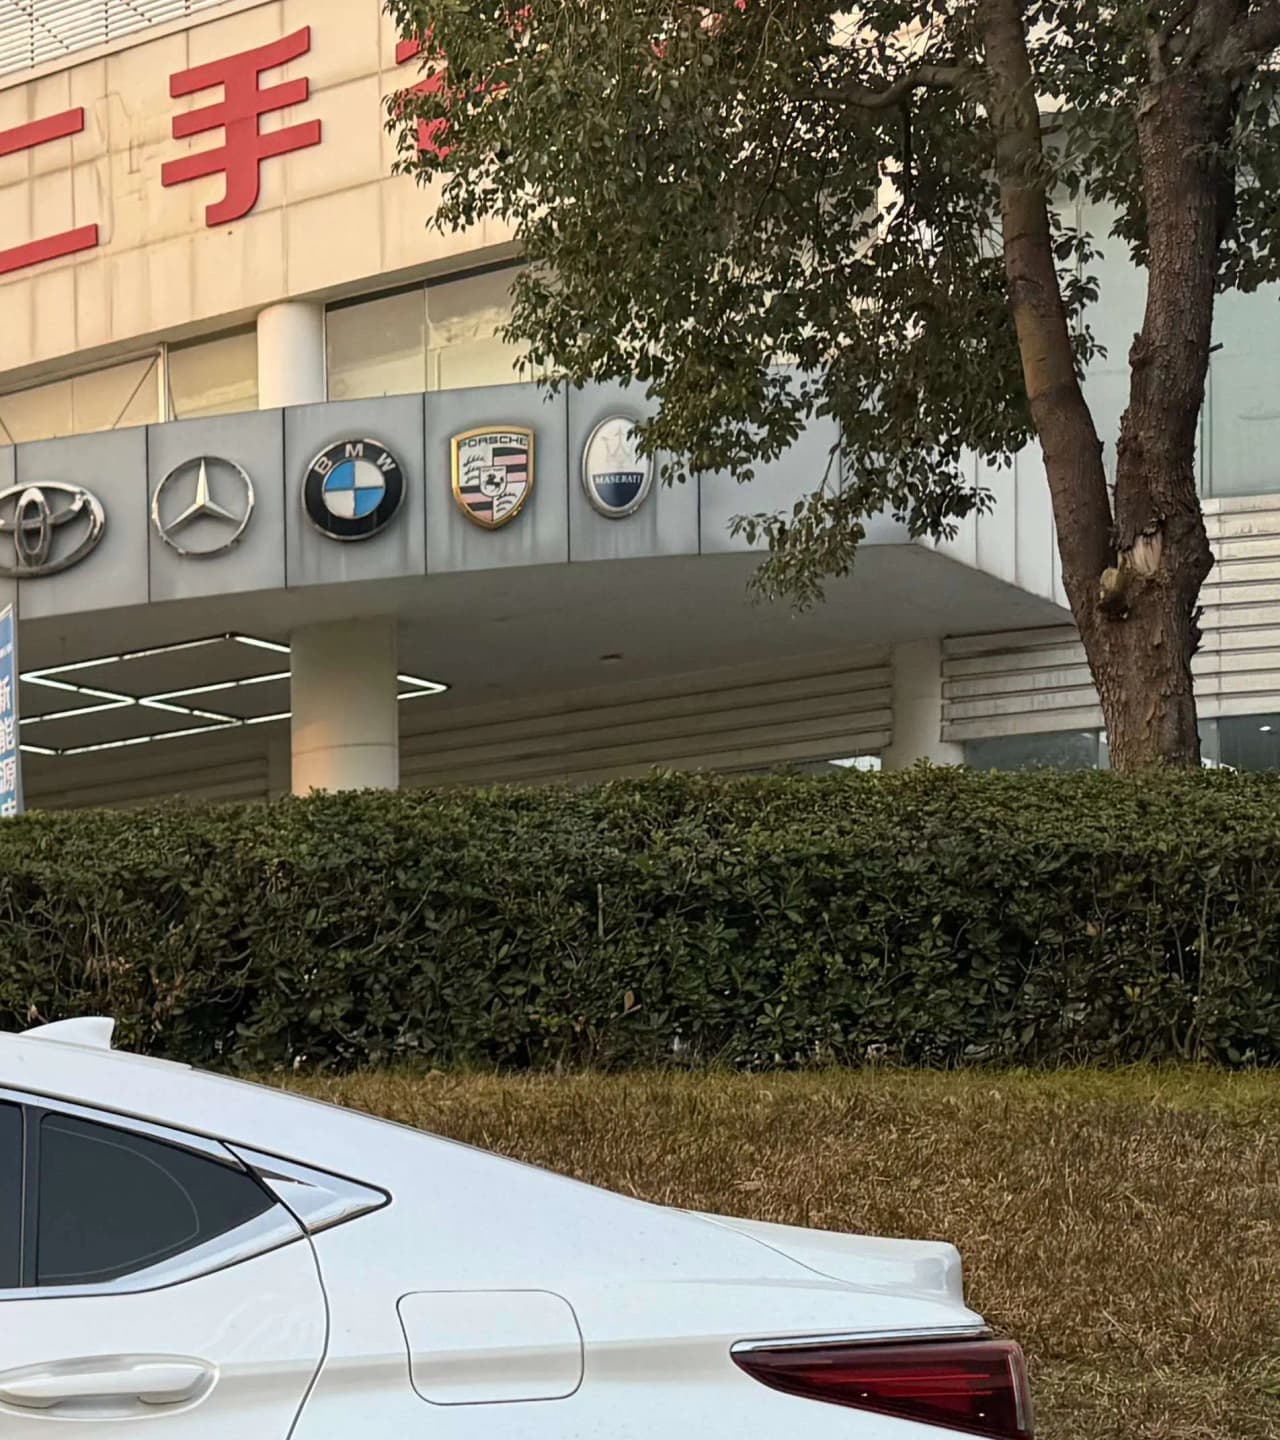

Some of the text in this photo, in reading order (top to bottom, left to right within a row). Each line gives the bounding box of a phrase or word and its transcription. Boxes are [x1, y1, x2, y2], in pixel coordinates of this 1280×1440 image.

[460, 434, 529, 449] PORSCHE
[313, 442, 397, 475] BMW
[594, 474, 642, 485] MASERATI
